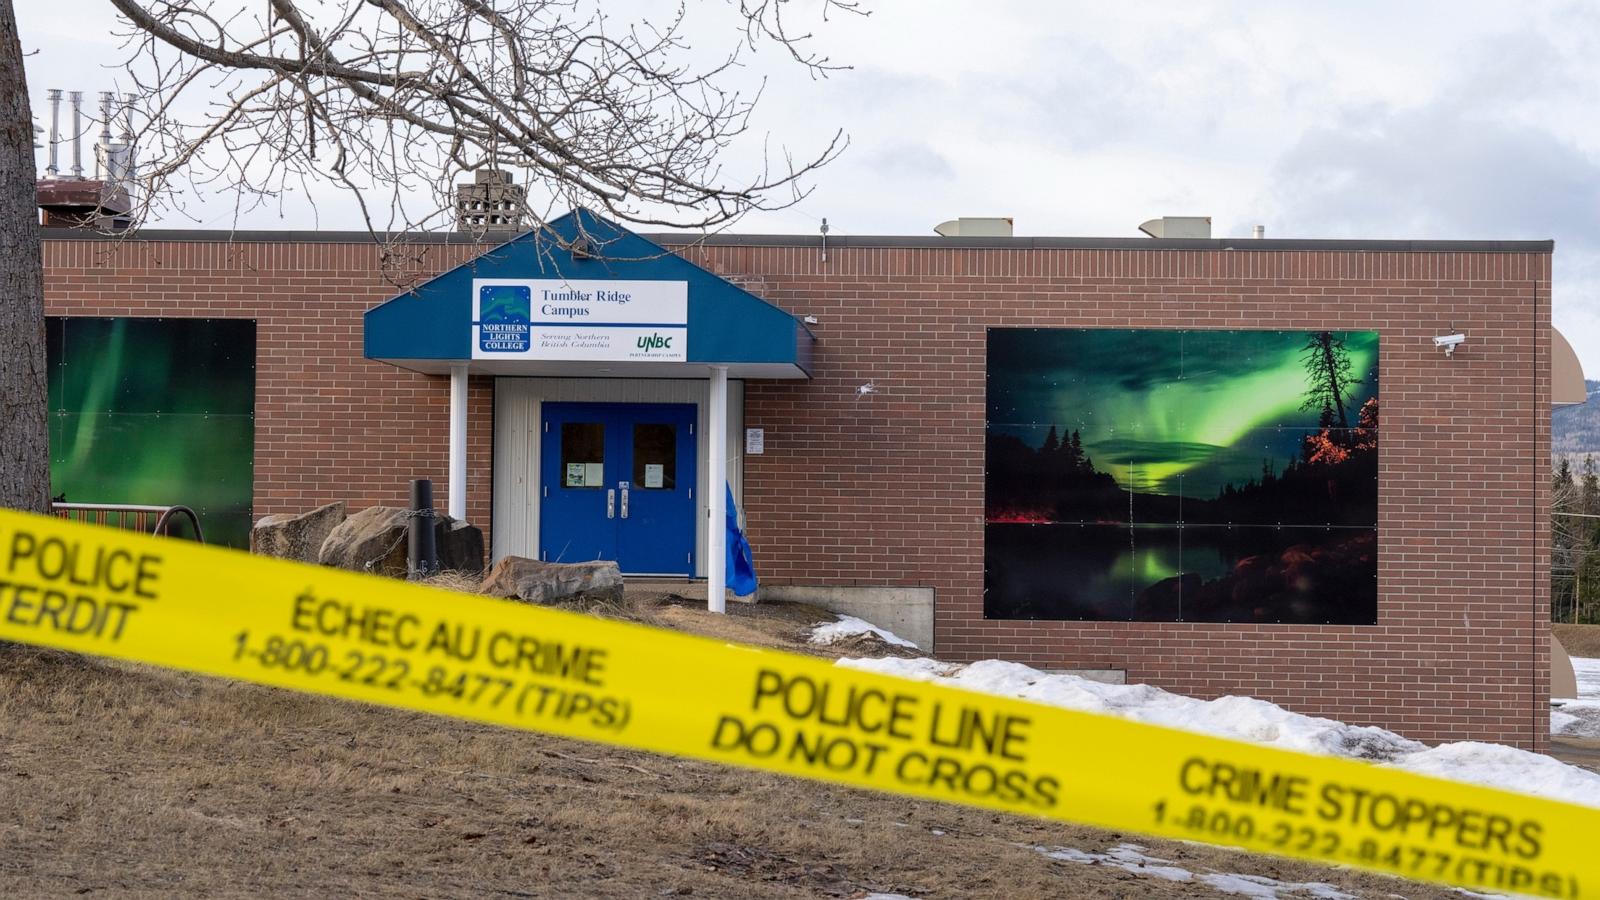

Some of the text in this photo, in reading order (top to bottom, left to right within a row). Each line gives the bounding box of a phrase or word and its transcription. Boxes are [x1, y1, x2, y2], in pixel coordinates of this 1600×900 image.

[541, 290, 631, 304] Tumbler Ridge
[541, 304, 590, 318] Campus
[485, 342, 524, 350] COLLEGE
[637, 332, 672, 353] UNBC
[7, 529, 163, 600] POLICE
[291, 585, 608, 687] ÉCHEC AU CRIME
[752, 668, 1032, 762] POLICE LINE
[711, 715, 1061, 809] DO NOT CROSS
[1179, 756, 1544, 861] CRIME STOPPERS
